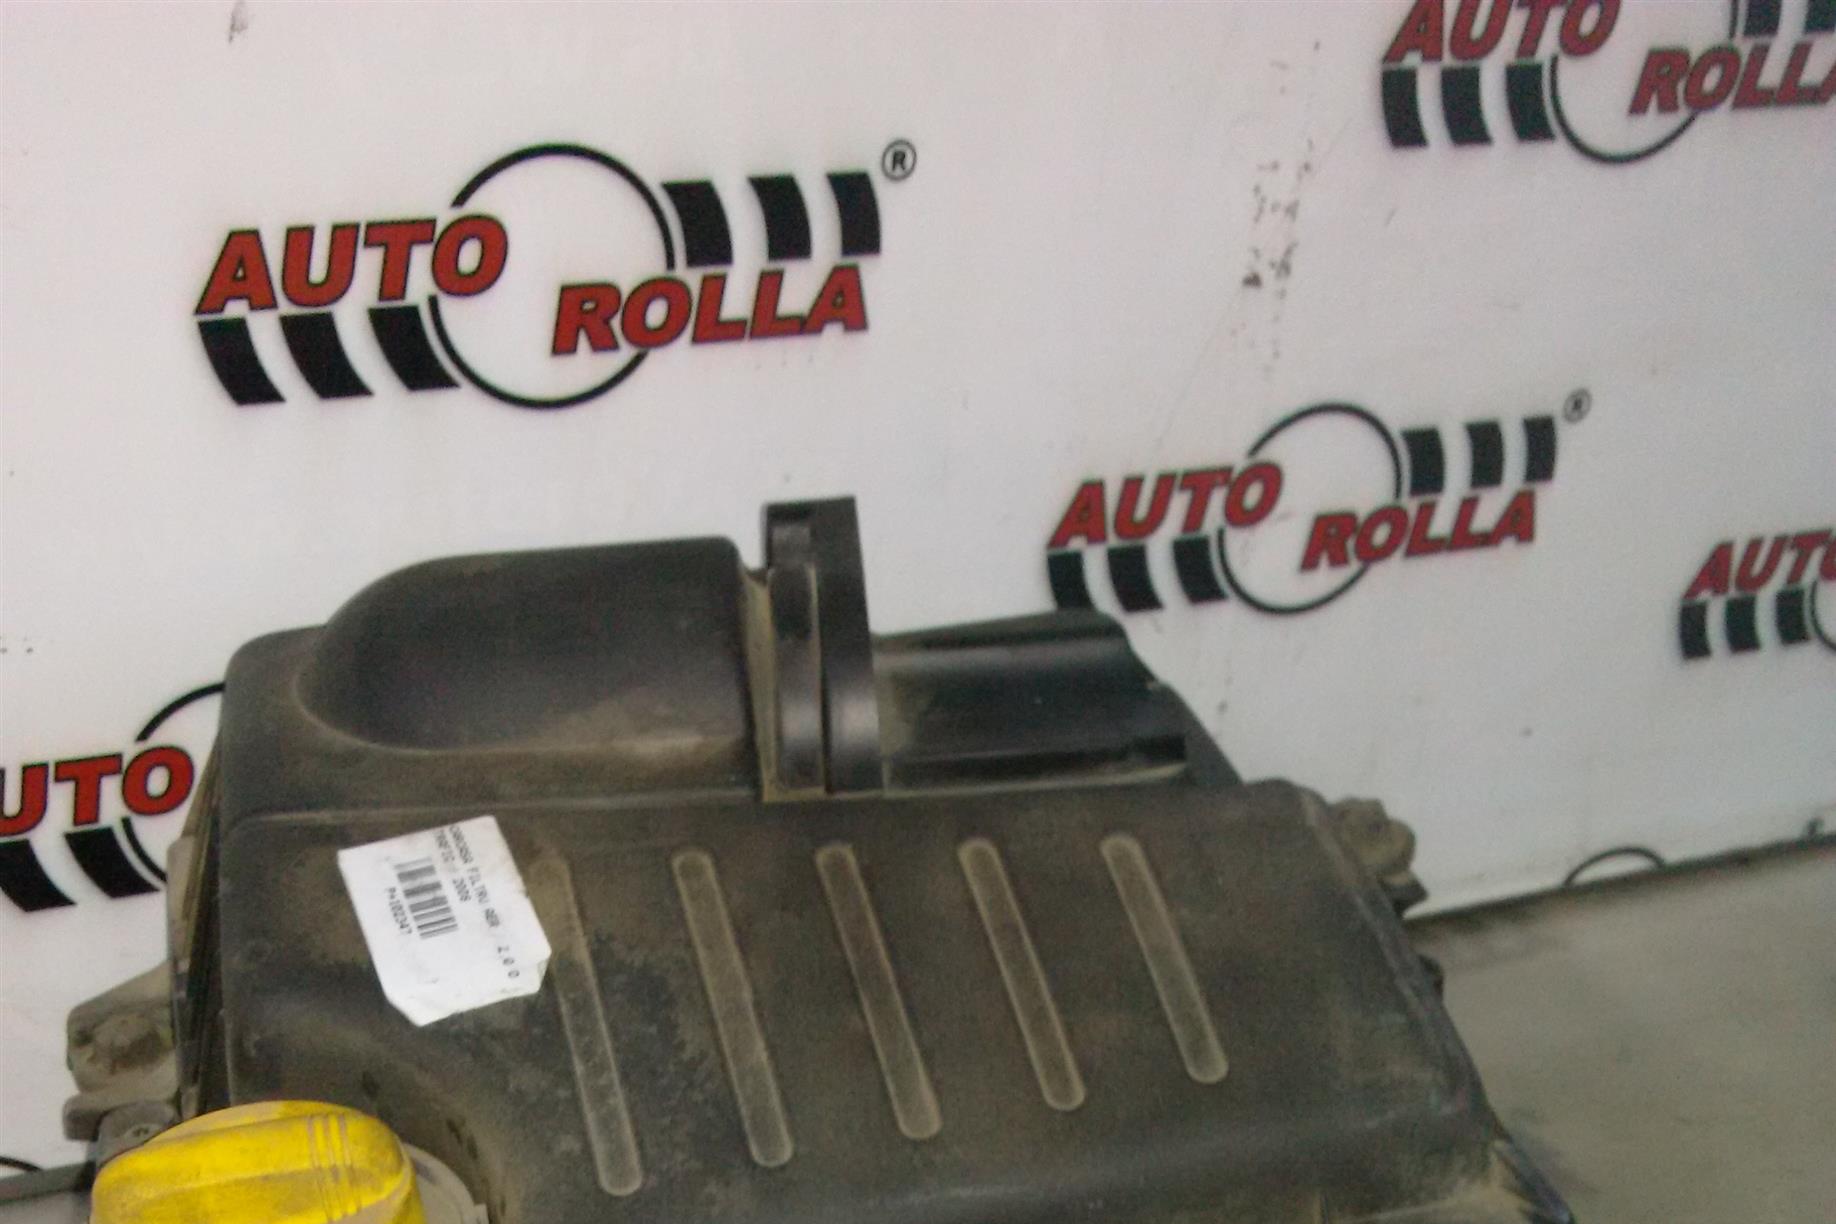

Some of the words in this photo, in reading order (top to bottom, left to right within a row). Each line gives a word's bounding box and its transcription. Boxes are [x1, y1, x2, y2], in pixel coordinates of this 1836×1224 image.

[1381, 0, 1620, 64] AUTO
[194, 214, 510, 315] AUTO
[550, 263, 869, 356] ROLLA
[1046, 461, 1284, 549] AUTO
[1300, 489, 1536, 572] ROLLA
